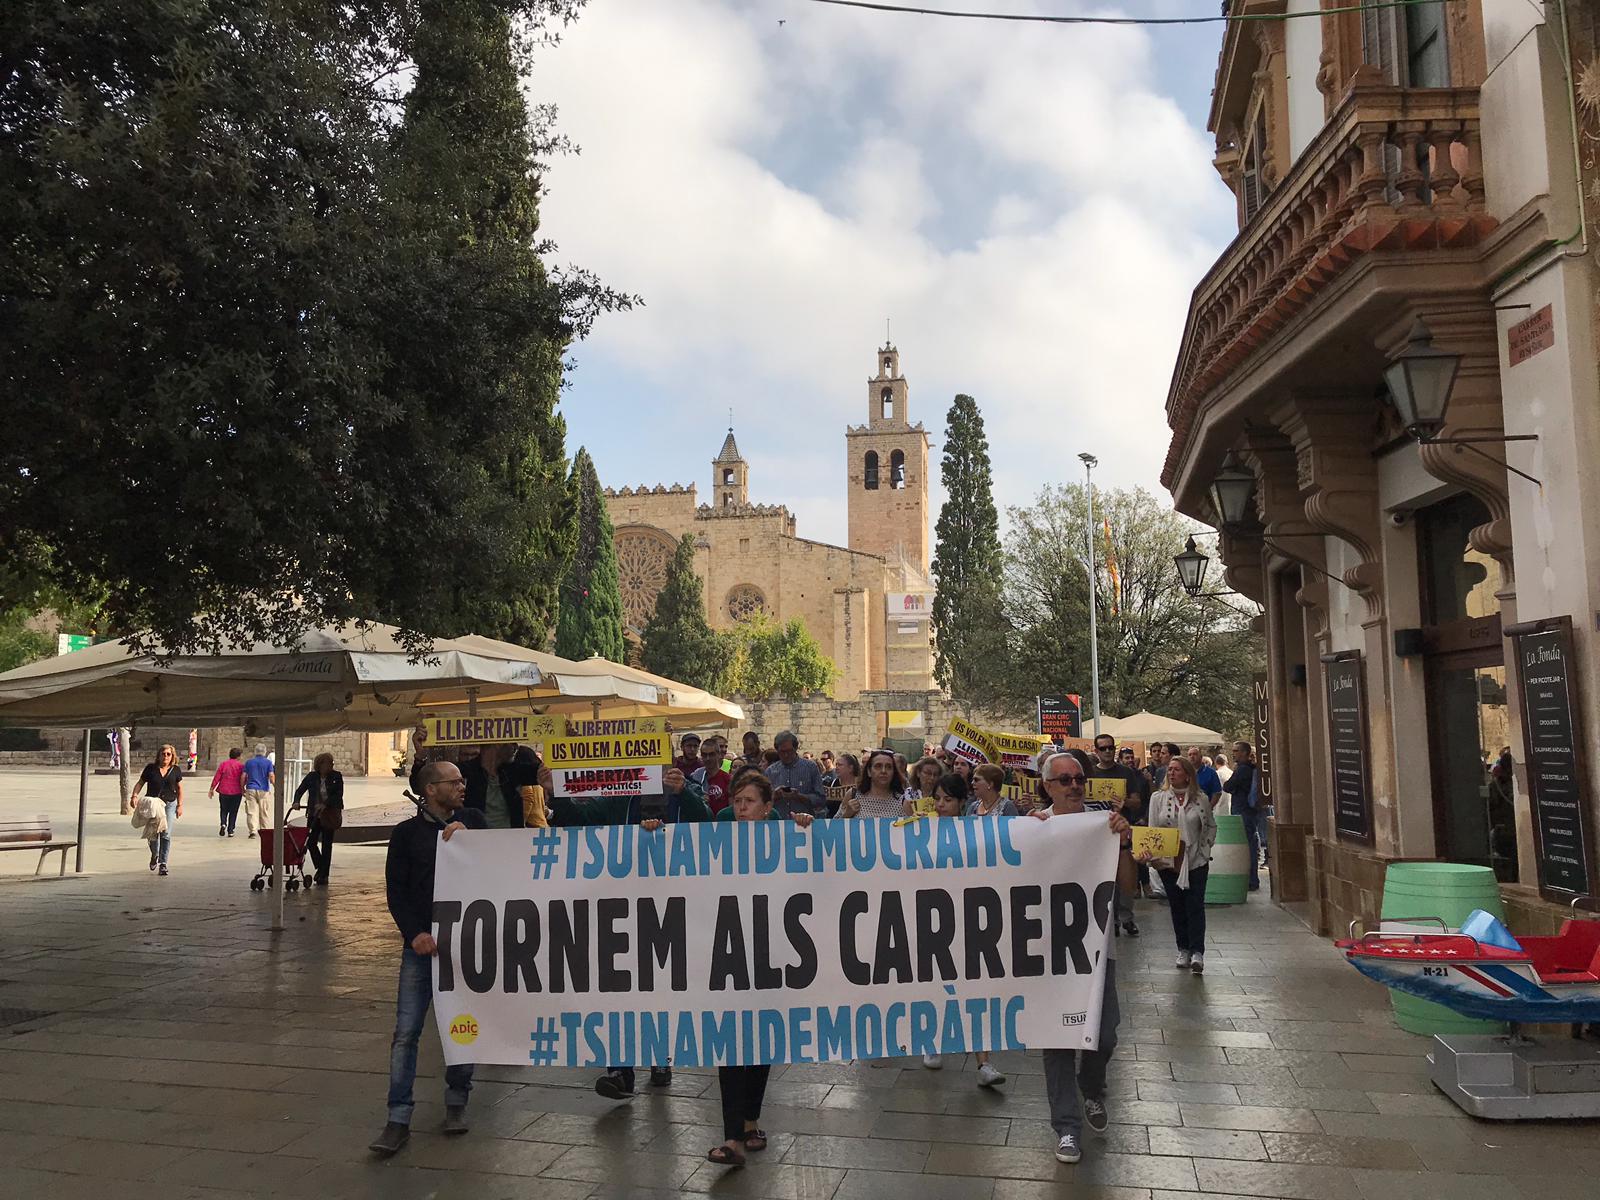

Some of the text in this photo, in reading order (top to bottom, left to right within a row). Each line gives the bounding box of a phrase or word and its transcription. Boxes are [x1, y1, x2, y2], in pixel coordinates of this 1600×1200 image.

[436, 717, 528, 740] LLIBERTAT!
[955, 722, 966, 734] US
[1255, 681, 1271, 797] MUSEU
[551, 739, 661, 760] US VOLEM A CASA!
[1018, 740, 1038, 753] CASA!
[564, 768, 643, 784] LLIBERTAT
[432, 897, 688, 994] TORNEM
[709, 893, 818, 991] ALS
[529, 985, 1026, 1067] #TSUNAMIDEMOCRÀTIC
